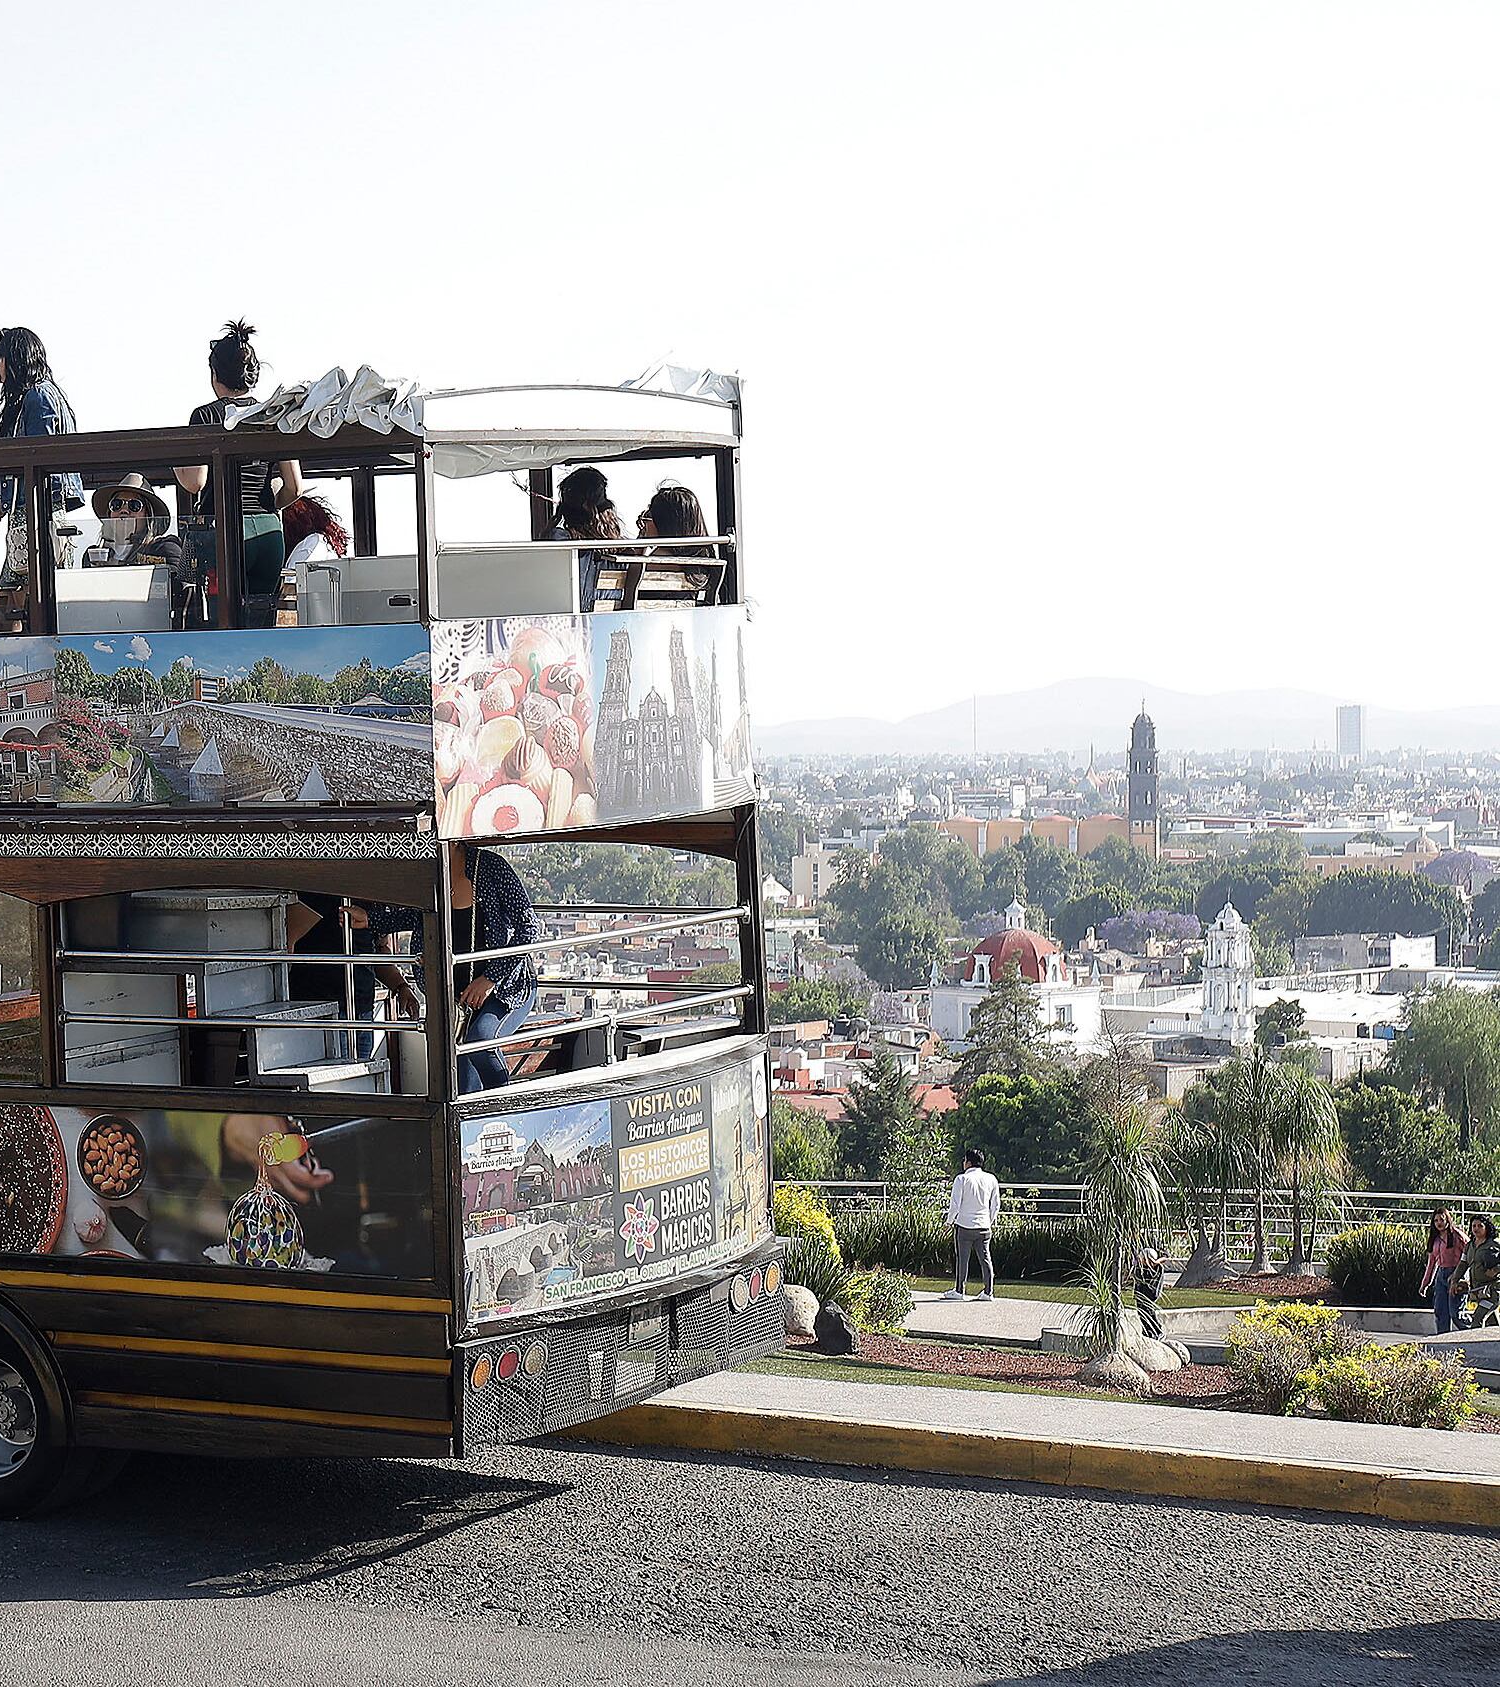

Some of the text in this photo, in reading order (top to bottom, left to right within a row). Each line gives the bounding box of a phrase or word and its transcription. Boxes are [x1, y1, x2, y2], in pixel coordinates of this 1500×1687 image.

[626, 1091, 674, 1118] VISITA
[676, 1084, 702, 1108] CON
[627, 1111, 703, 1141] Barrios Antiguos
[470, 1159, 495, 1170] Barrios
[621, 1135, 709, 1171] LOS HISTÓRICOS
[621, 1151, 709, 1187] Y TRADICIONALES
[660, 1178, 711, 1220] BARRIOS
[661, 1212, 712, 1256] MÁGICOS
[545, 1284, 568, 1300] SAN
[569, 1273, 624, 1295] FRANCISCO
